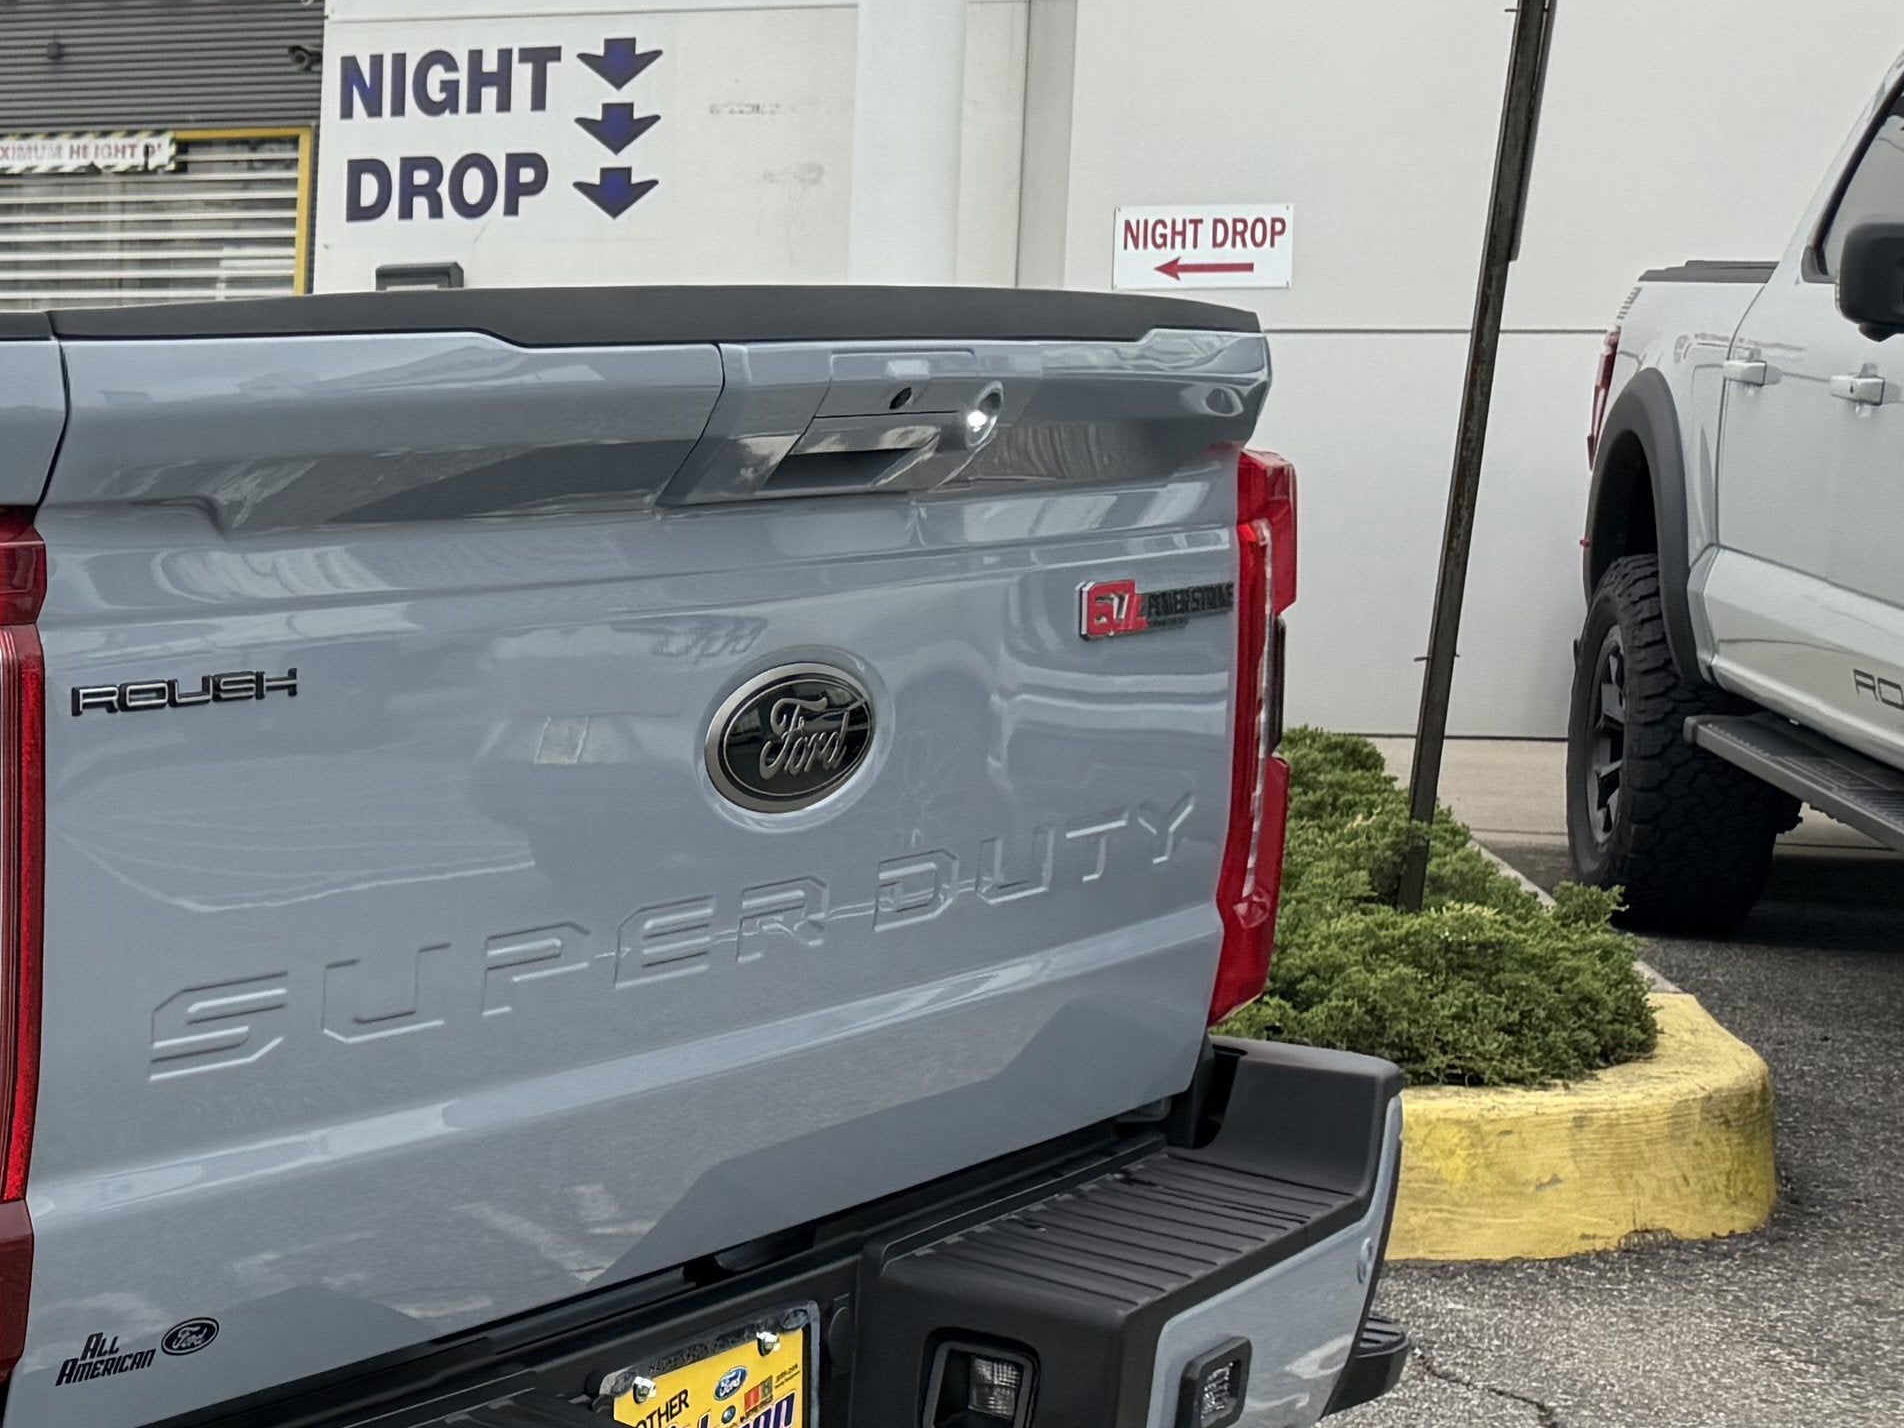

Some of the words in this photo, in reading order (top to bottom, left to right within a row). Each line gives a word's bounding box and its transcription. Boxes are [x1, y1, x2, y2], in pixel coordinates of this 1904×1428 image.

[339, 45, 562, 120] NIGHT
[69, 143, 138, 160] HEIGHT
[345, 152, 549, 223] DROP
[1123, 218, 1204, 251] NIGHT
[1212, 217, 1287, 249] DROP
[72, 668, 298, 716] ROUSH
[149, 876, 830, 1080] SUPER
[873, 794, 1195, 932] DUTY
